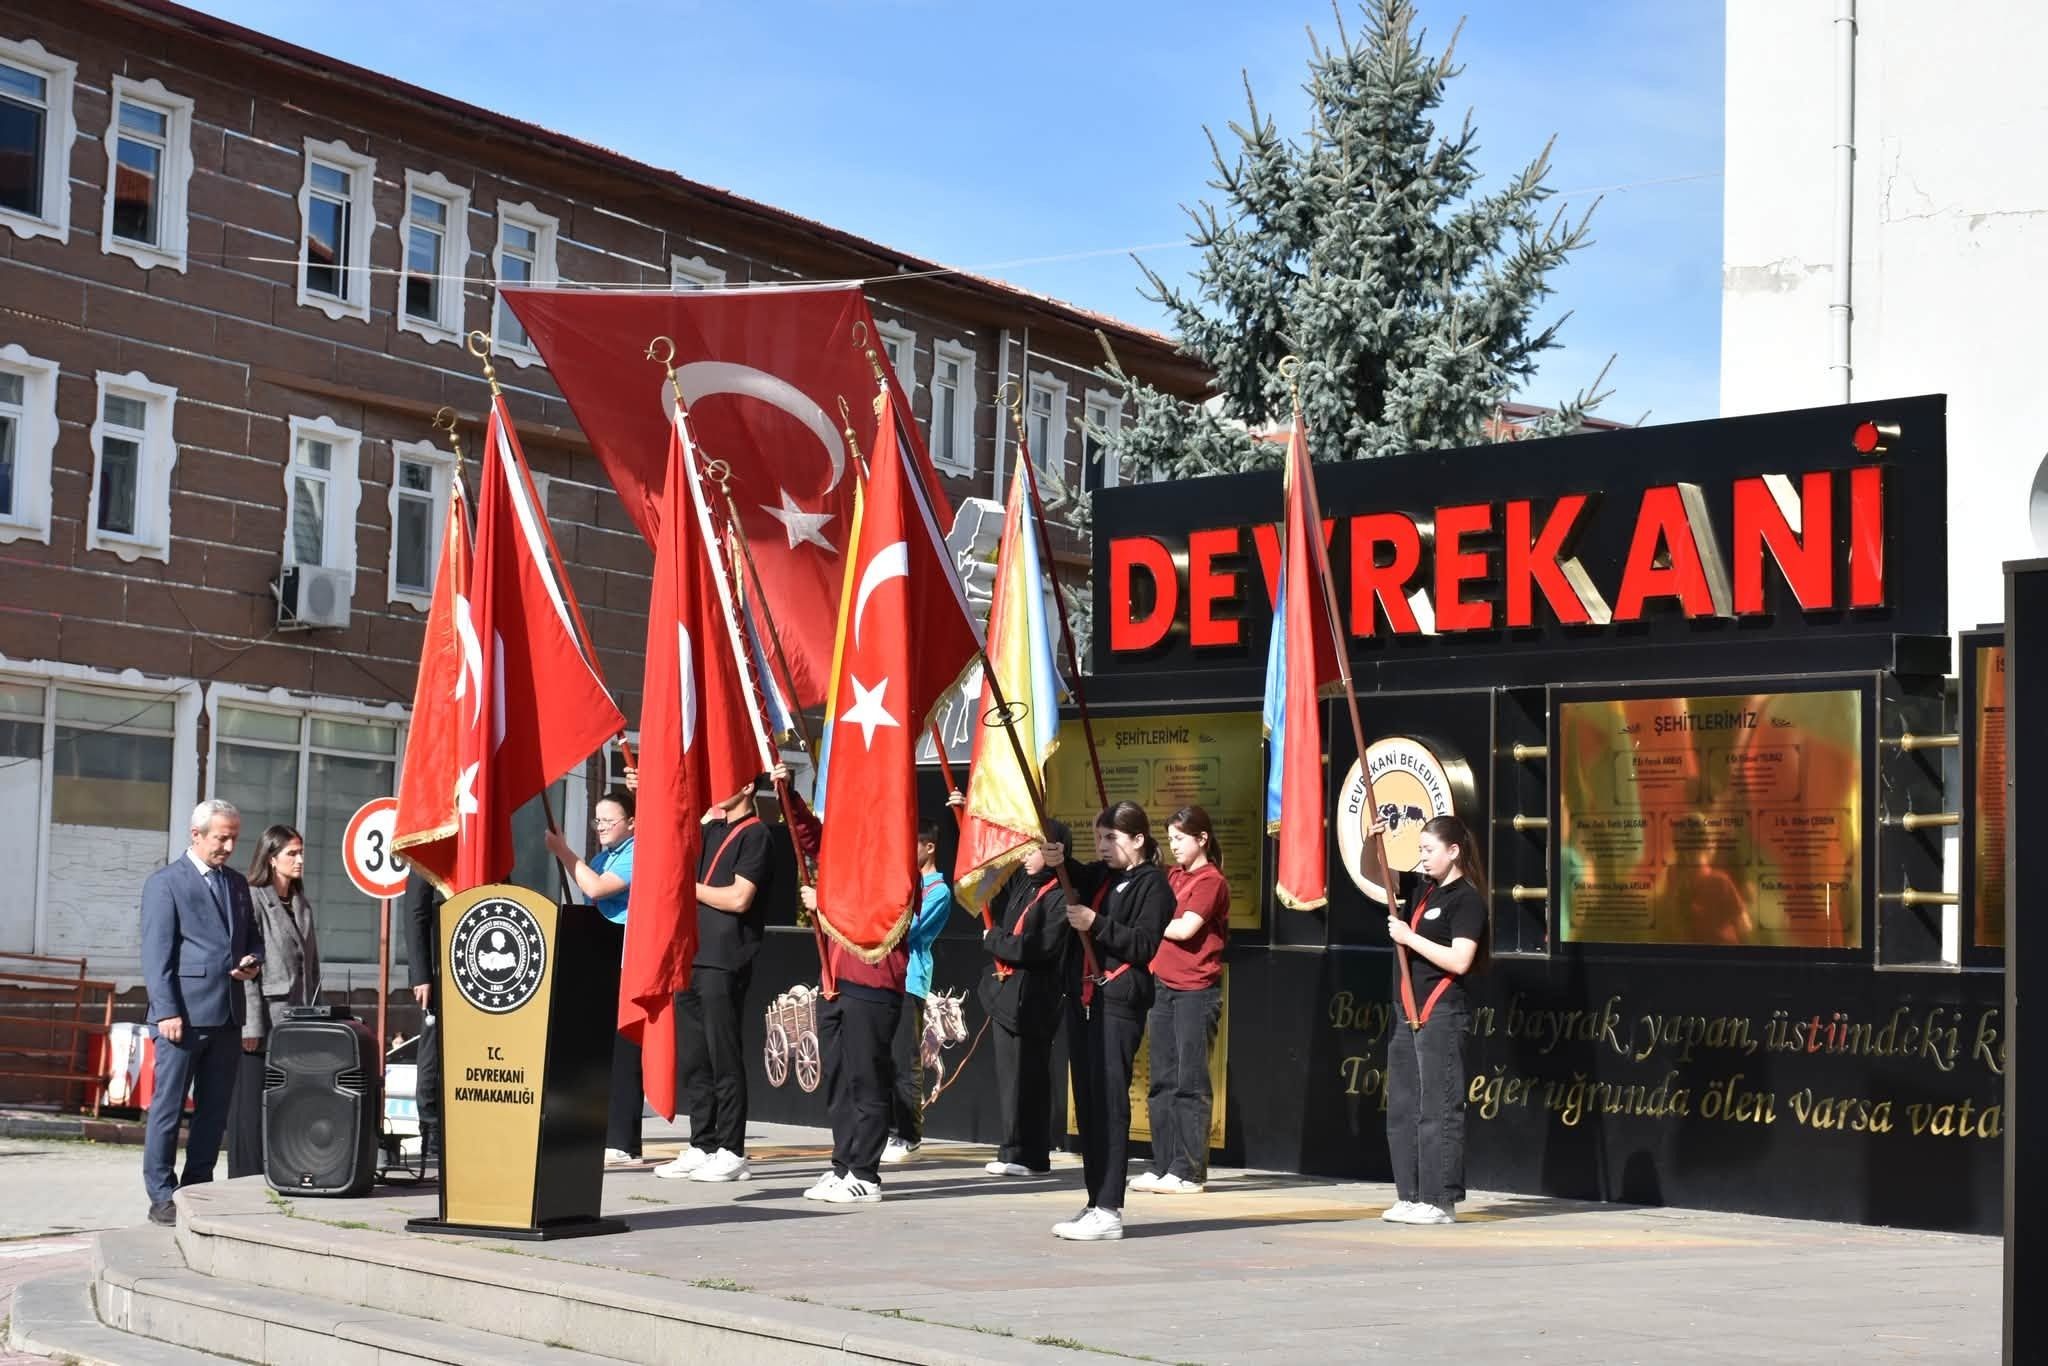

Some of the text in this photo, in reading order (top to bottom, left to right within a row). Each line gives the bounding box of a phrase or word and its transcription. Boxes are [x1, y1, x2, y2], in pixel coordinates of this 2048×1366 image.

[1654, 708, 1757, 736] ŞEHİTLERİMİZ
[1115, 726, 1190, 749] ŞEHİTLERİMİZ
[1506, 992, 1630, 1055] bayrak
[1635, 1014, 1758, 1062] yapan,
[1765, 1005, 1962, 1072] üstündeki
[487, 1046, 505, 1061] T.C.
[466, 1066, 525, 1084] DEVREKANİ
[455, 1087, 534, 1105] KAYMAKAMLIĞI
[1468, 1064, 1538, 1120] eğer
[1544, 1070, 1691, 1126] uğrunda
[1701, 1073, 1777, 1124] ölen
